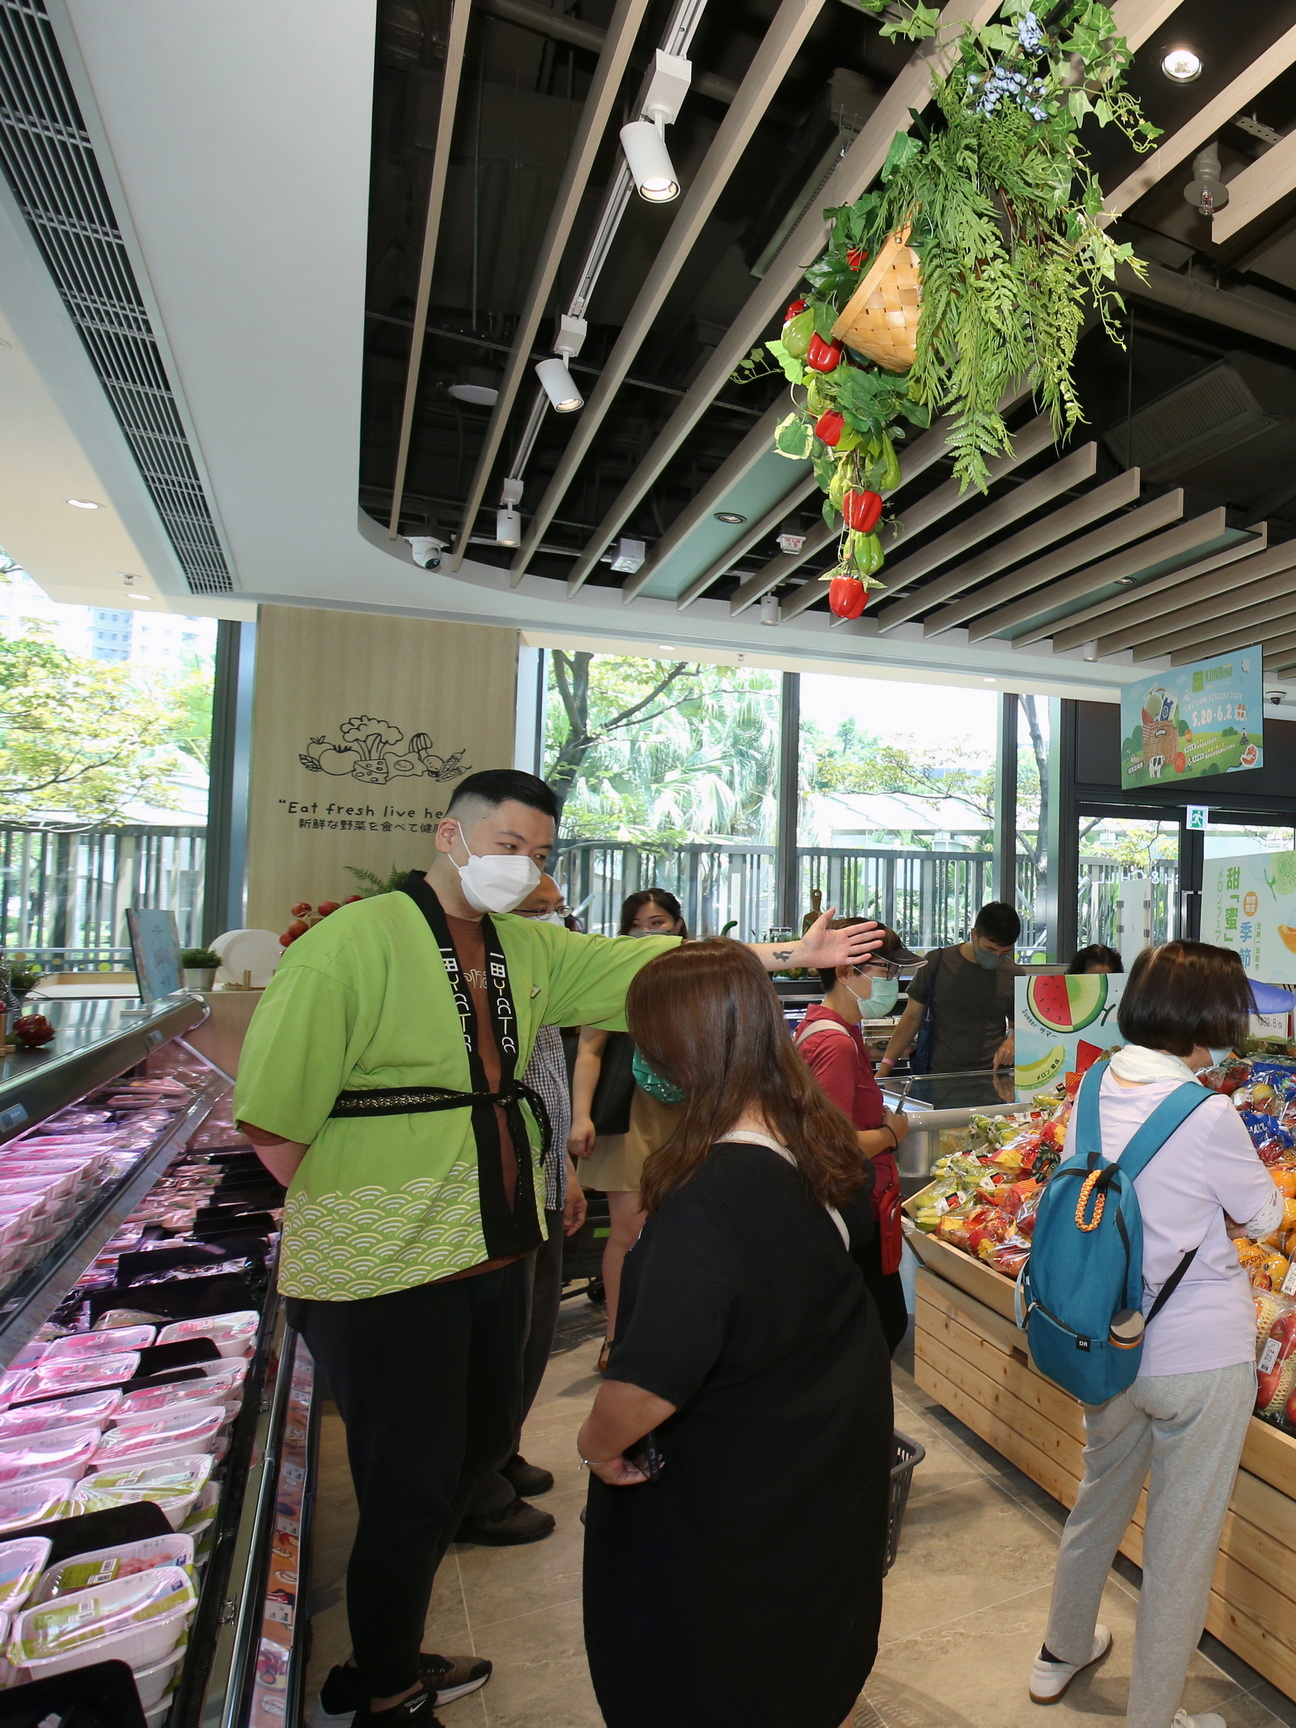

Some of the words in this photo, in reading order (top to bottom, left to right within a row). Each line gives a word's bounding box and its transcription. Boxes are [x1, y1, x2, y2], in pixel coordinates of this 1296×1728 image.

[326, 803, 375, 817] fresh
[384, 805, 416, 818] live
[424, 807, 443, 819] he
[298, 818, 440, 834] 新鮮な野菜を食べて健
